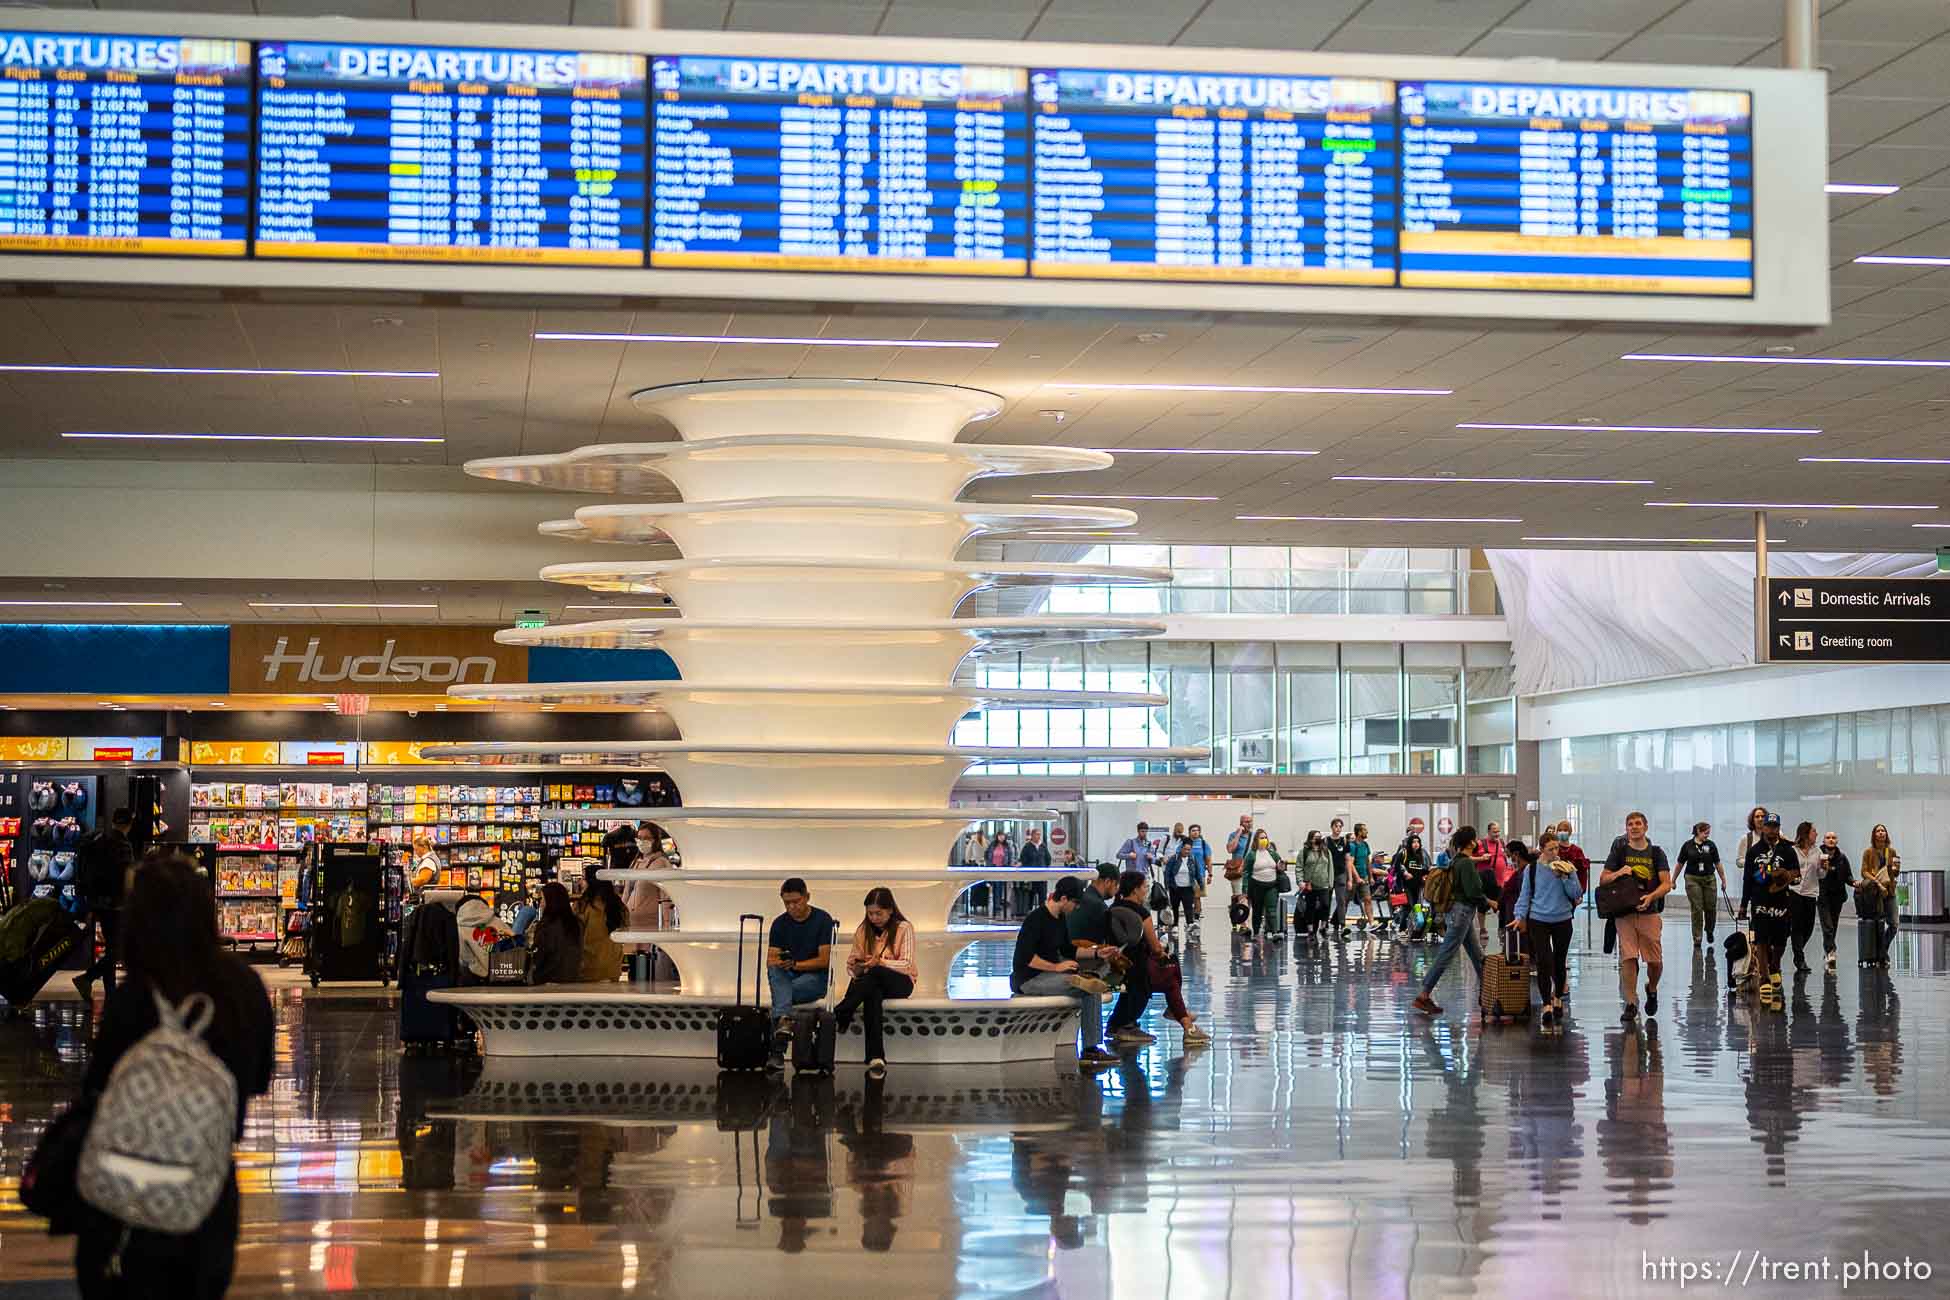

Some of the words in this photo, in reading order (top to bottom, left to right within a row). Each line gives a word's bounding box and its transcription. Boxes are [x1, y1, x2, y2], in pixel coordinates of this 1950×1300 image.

[0, 36, 178, 68] ARTURES
[338, 49, 576, 83] DEPARTURES
[56, 70, 87, 81] Gate
[730, 61, 960, 96] DEPARTURES
[1106, 73, 1329, 107] DEPARTURES
[1471, 87, 1688, 121] DEPARTURES
[1820, 591, 1880, 606] Domestic
[1883, 591, 1931, 606] Arrivals
[1820, 635, 1865, 649] Greeting
[1867, 638, 1893, 647] room
[262, 636, 497, 683] Hudson
